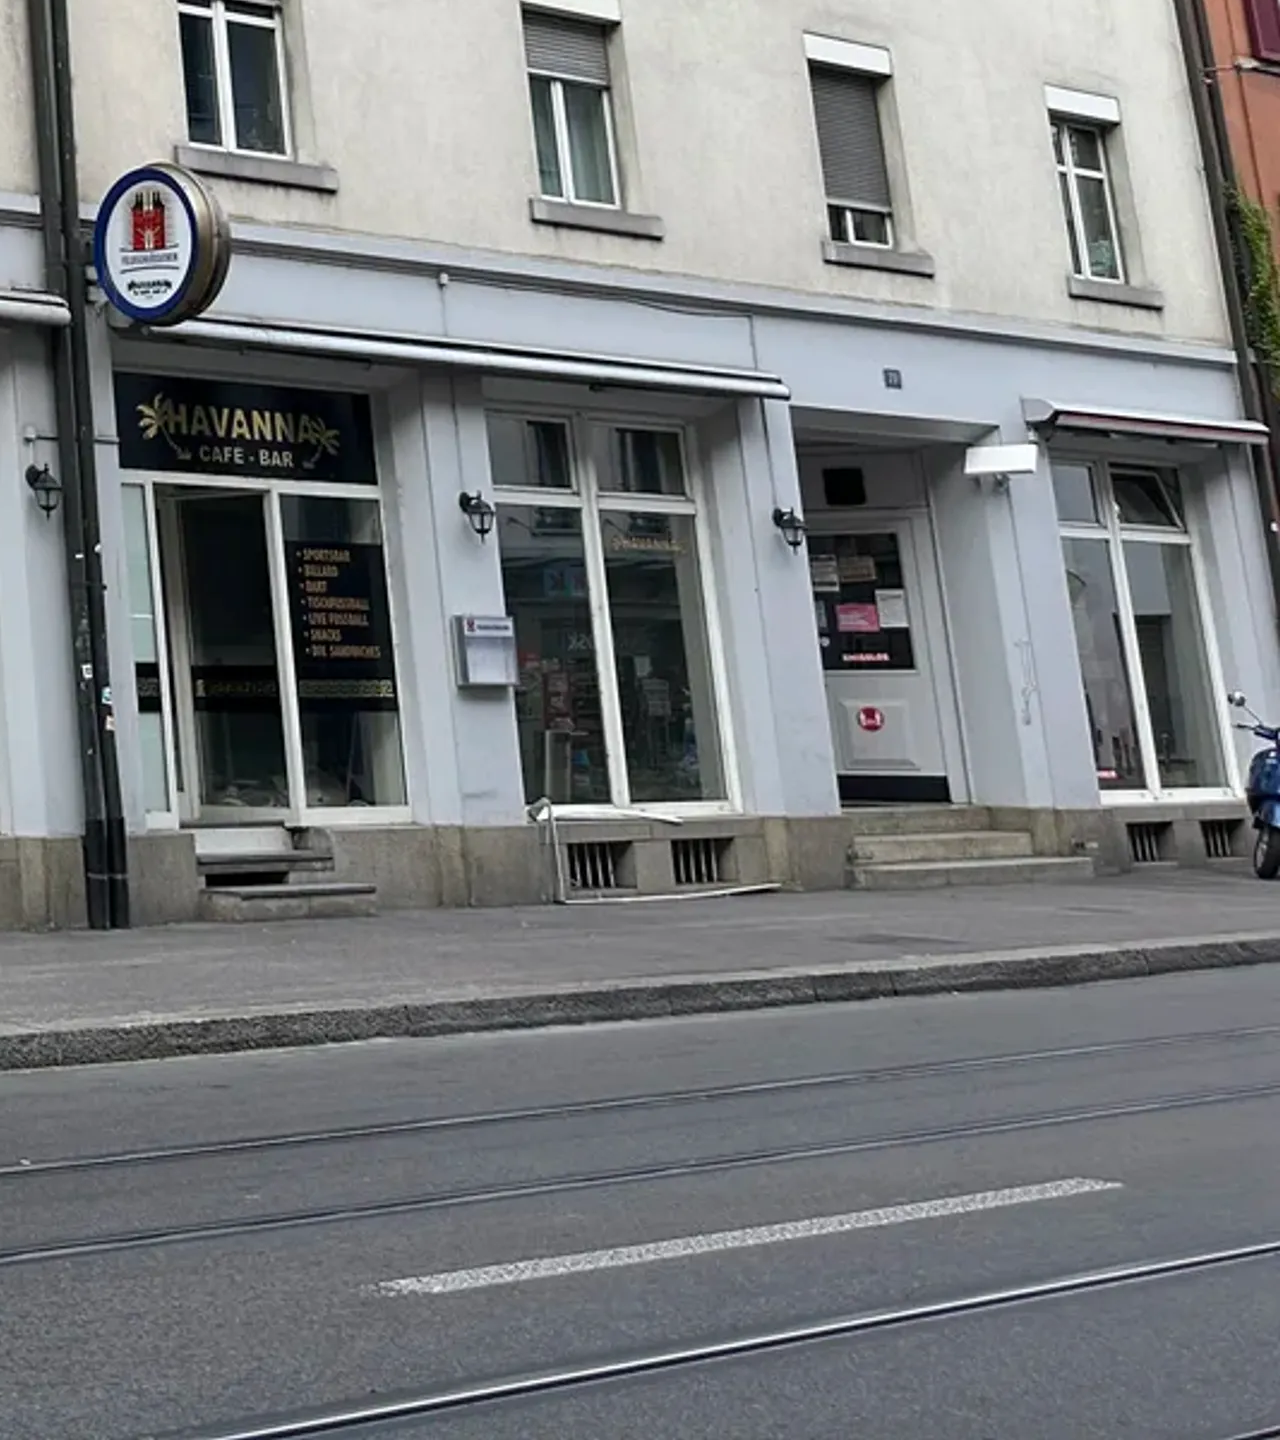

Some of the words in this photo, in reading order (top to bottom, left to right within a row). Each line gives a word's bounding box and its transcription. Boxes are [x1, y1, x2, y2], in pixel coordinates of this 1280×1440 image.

[167, 400, 317, 444] HAVANNA
[199, 444, 244, 465] CAFE
[259, 448, 294, 468] BAR
